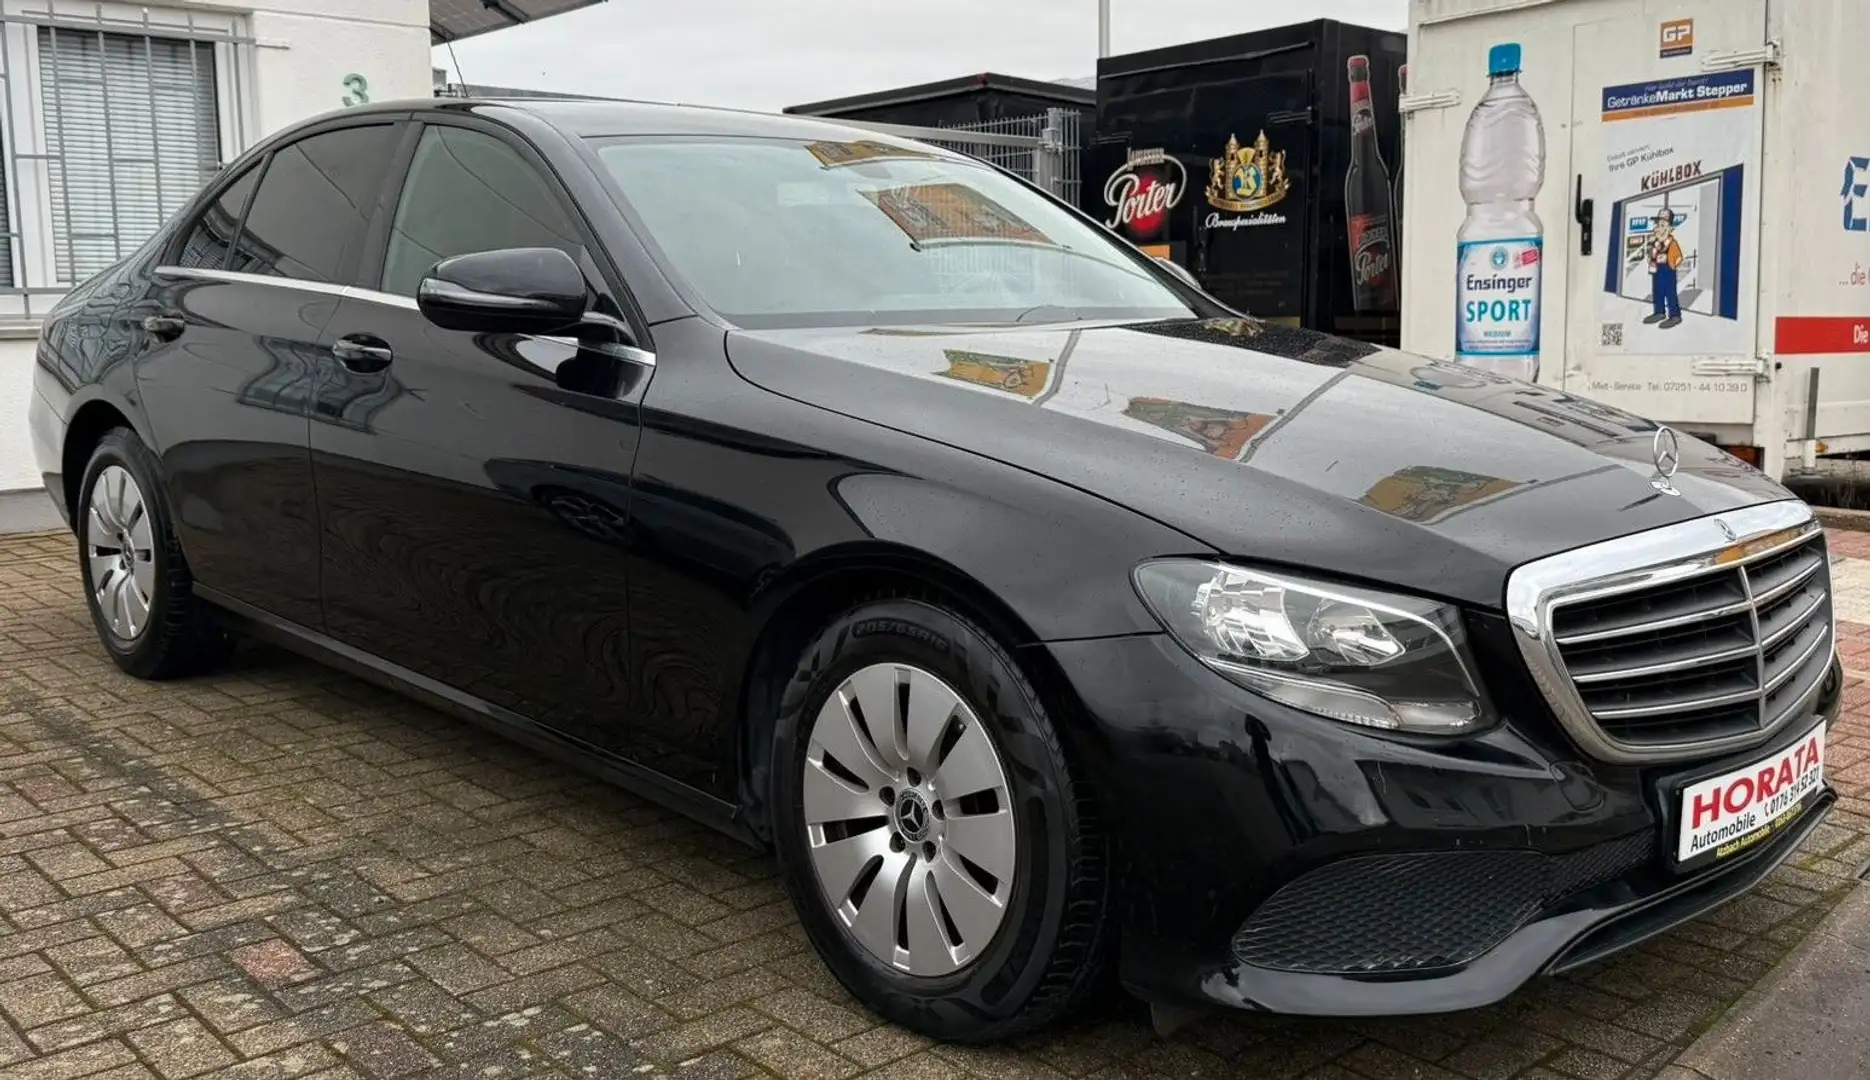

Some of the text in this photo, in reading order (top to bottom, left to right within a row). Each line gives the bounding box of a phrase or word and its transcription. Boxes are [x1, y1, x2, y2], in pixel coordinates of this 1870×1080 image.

[1663, 24, 1691, 42] GP
[342, 73, 369, 107] 3
[1607, 90, 1694, 108] GetränkeMarkt
[1696, 82, 1747, 98] Stepper
[1626, 156, 1640, 167] GP
[1641, 146, 1674, 163] Kühlbox
[1641, 160, 1702, 191] KÜHLBOX
[1104, 172, 1178, 229] Porter
[1466, 273, 1532, 293] Ensinger
[1466, 299, 1531, 322] SPORT
[1853, 324, 1868, 344] Die
[1692, 736, 1819, 829] HORATA
[1690, 813, 1756, 852] Automobile
[1770, 790, 1788, 814] 0176
